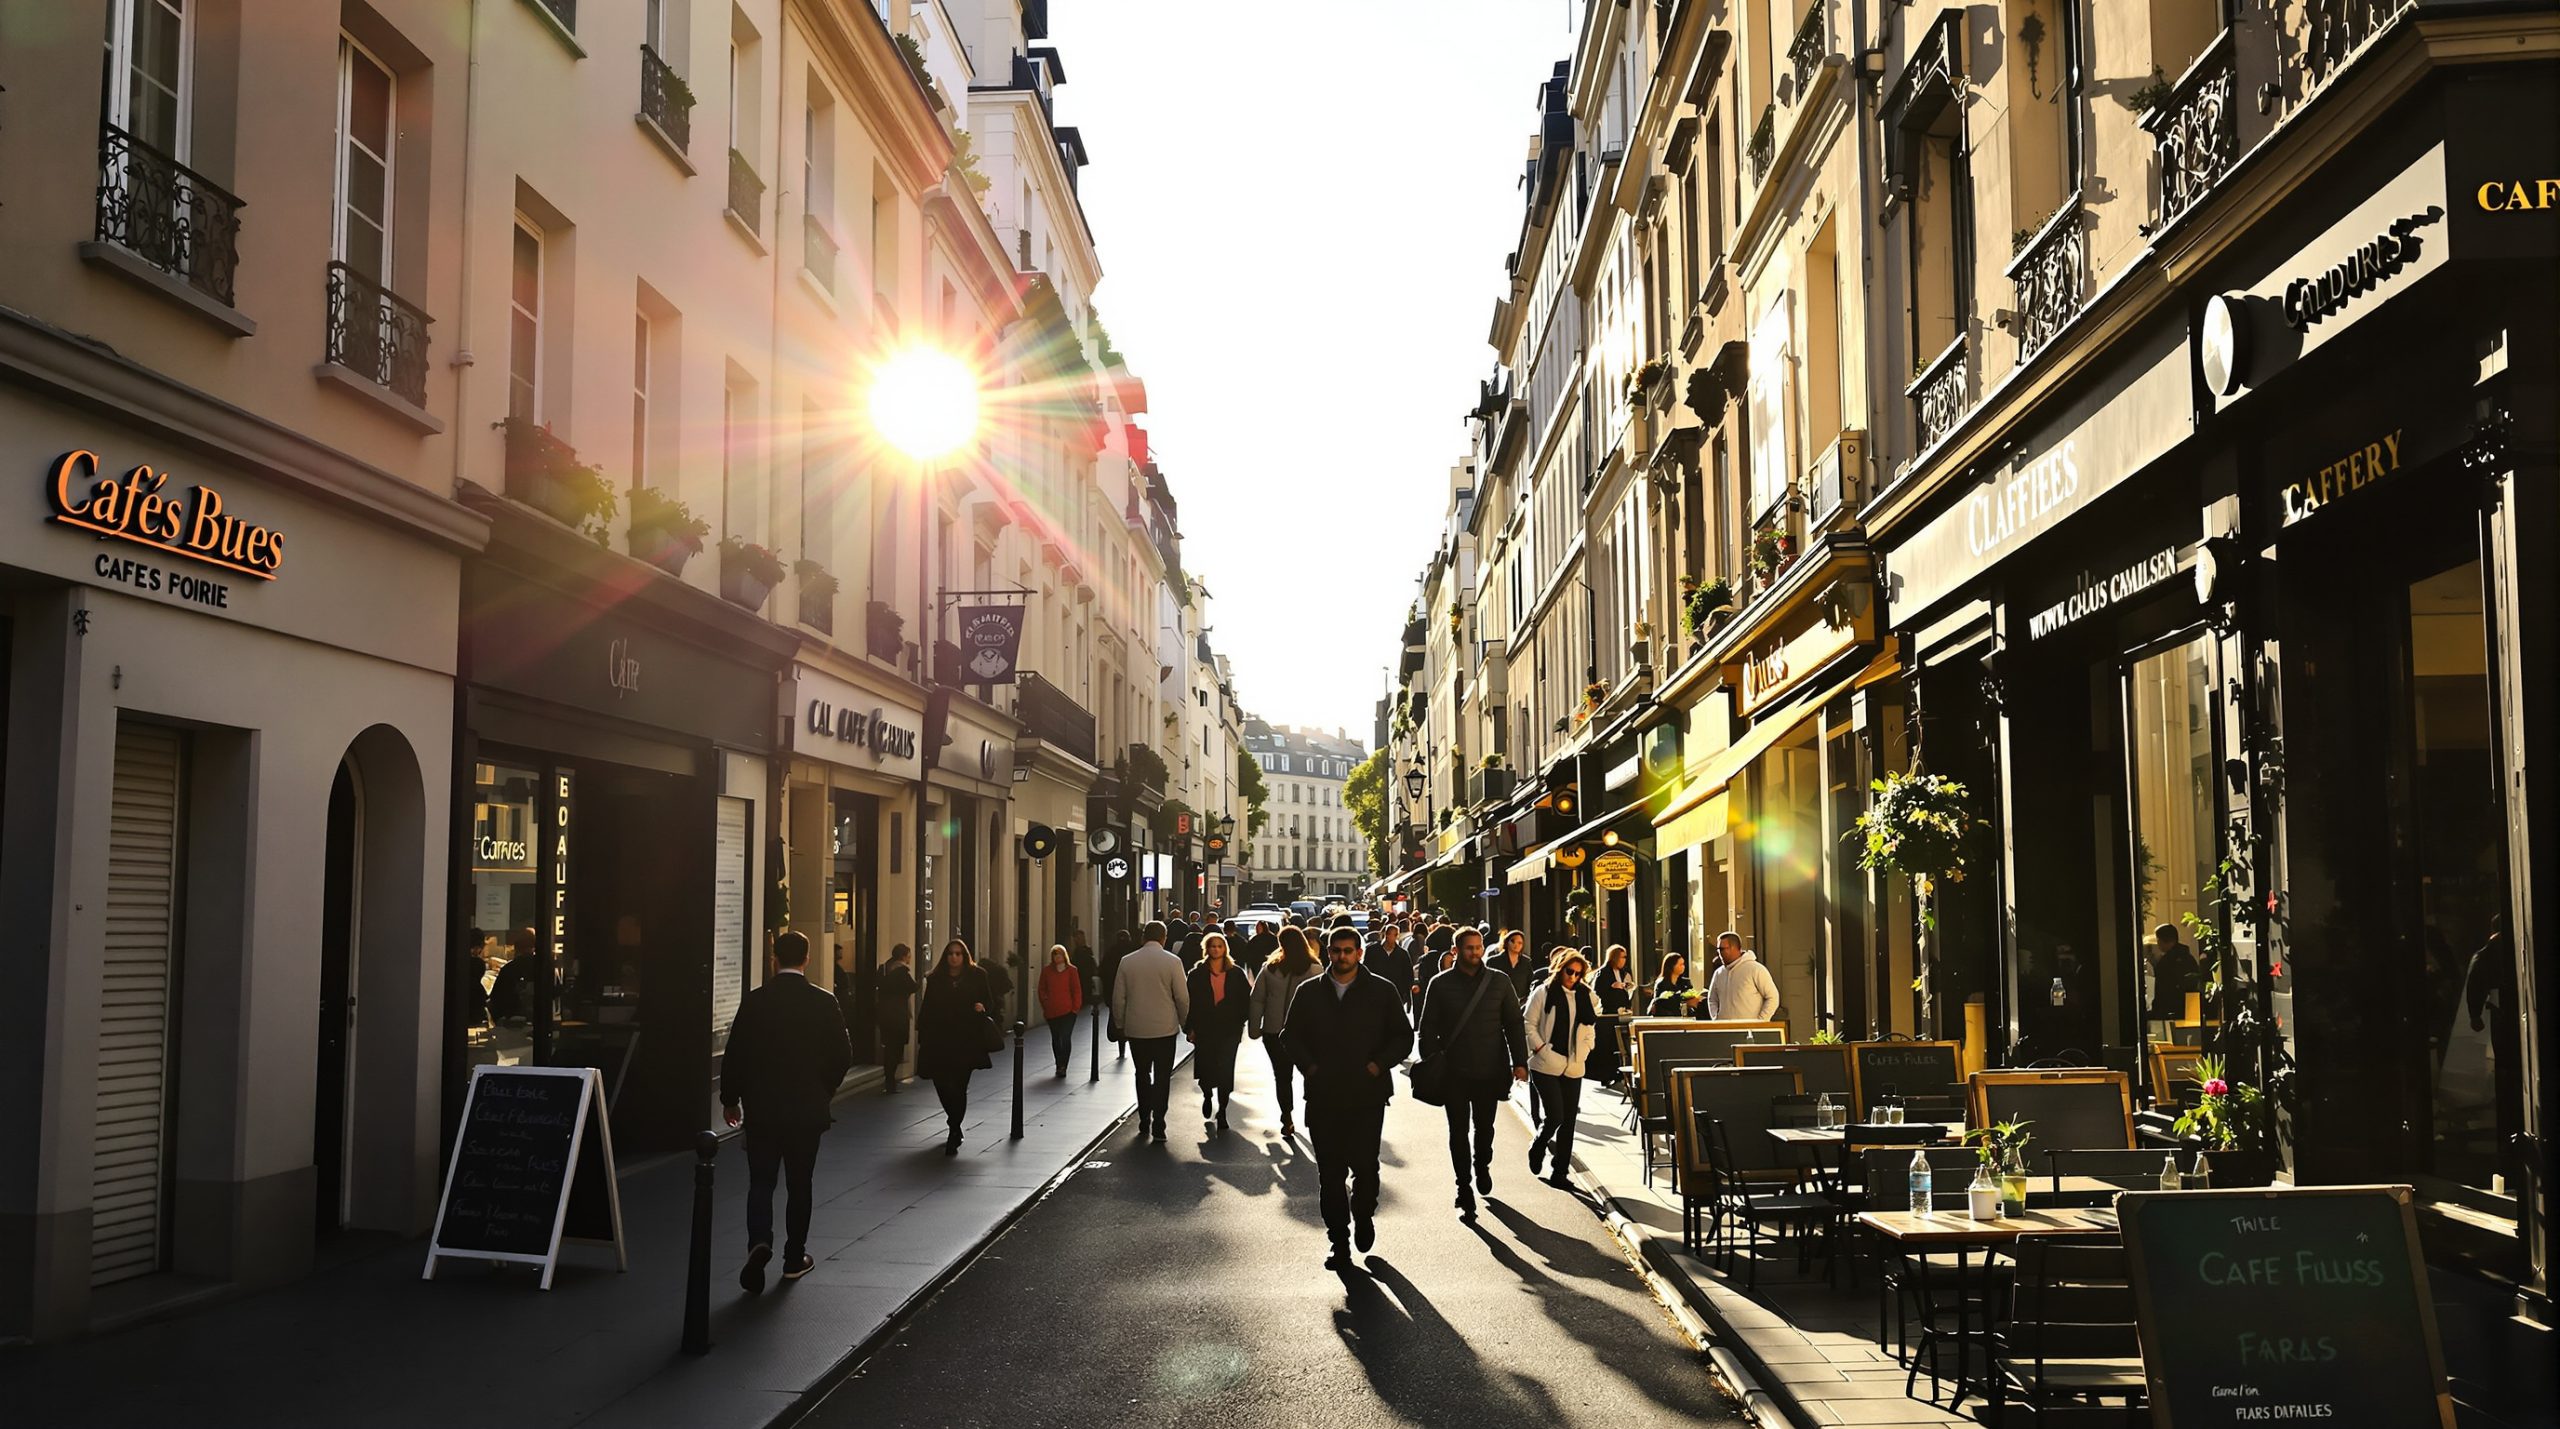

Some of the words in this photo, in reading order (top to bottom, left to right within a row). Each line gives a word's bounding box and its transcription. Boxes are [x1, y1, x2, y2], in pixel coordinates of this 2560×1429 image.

[2285, 428, 2402, 521] CAFFERY
[53, 450, 182, 538] Cafés
[188, 485, 285, 569] Bues
[95, 553, 161, 591] CAFES
[169, 572, 228, 608] FOIRIE
[808, 699, 834, 737] CAL
[2200, 1252, 2280, 1285] CAFE
